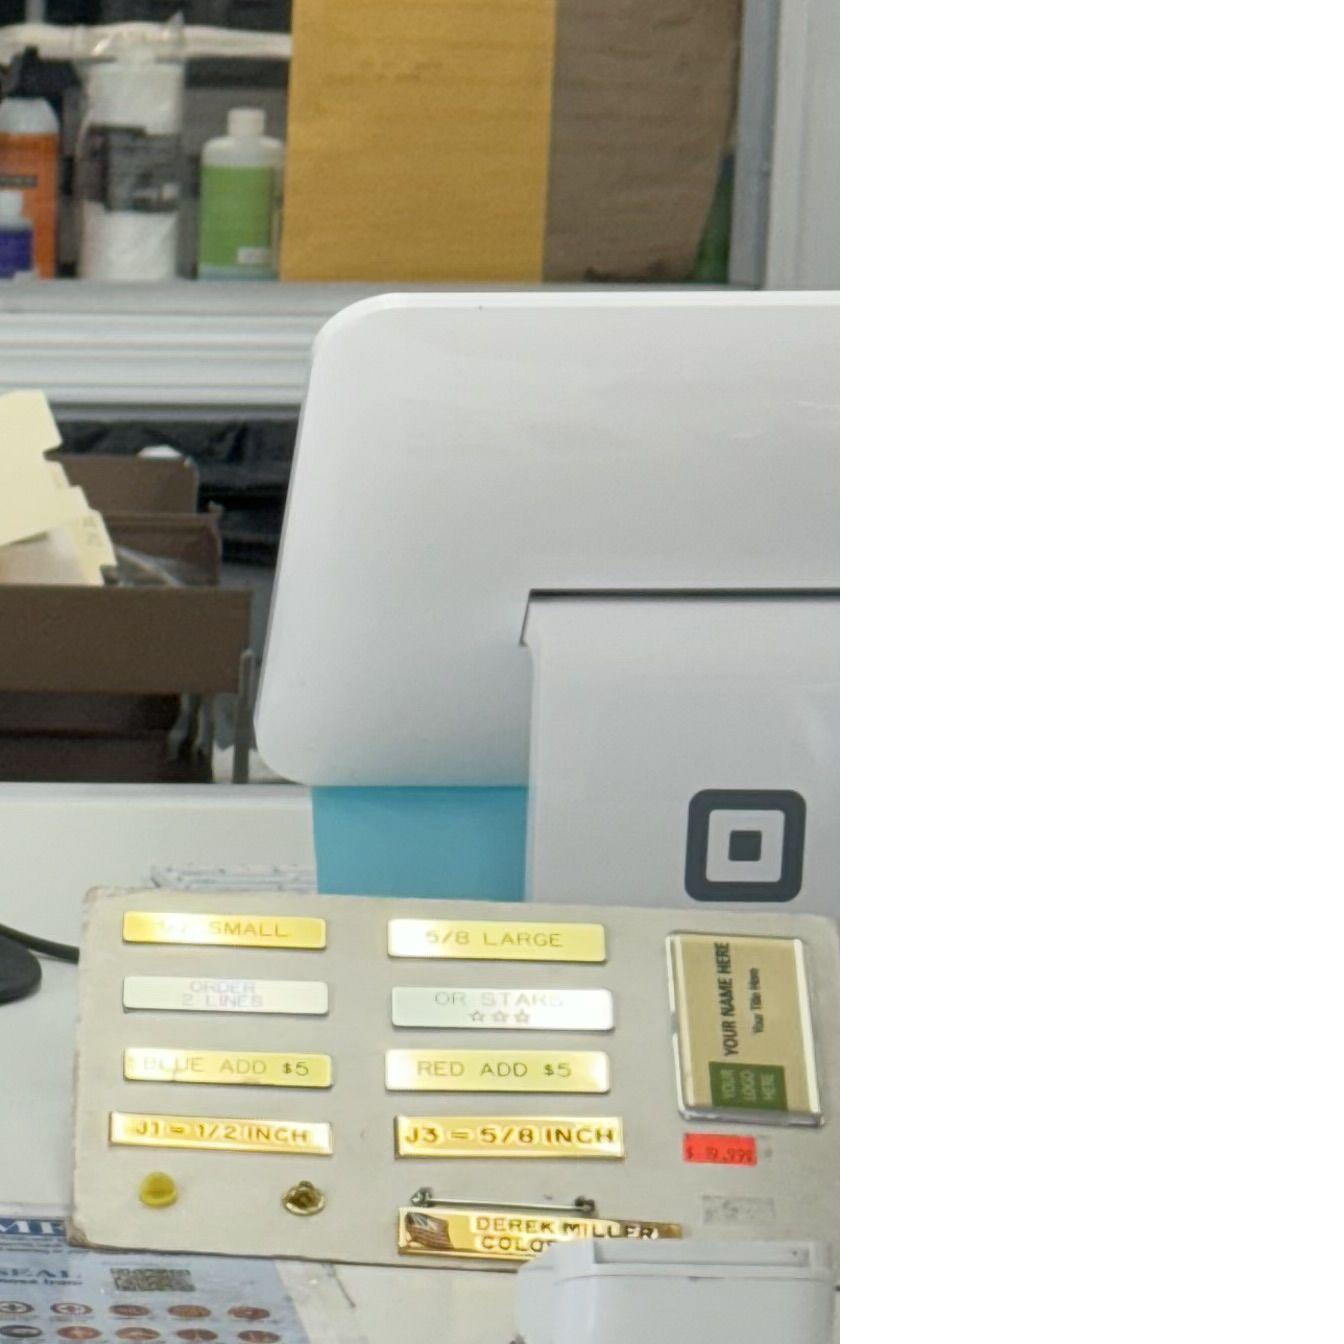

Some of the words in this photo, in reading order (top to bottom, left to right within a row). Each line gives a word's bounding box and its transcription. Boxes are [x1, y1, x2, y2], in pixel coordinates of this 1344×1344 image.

[208, 922, 289, 939] SMALL
[424, 929, 471, 946] 5/8
[483, 931, 564, 948] LARGE
[714, 941, 731, 974] HERE
[433, 991, 468, 1006] OR
[717, 977, 735, 1017] NAME
[722, 1019, 739, 1057] YOUR
[219, 1058, 267, 1074] ADD
[282, 1061, 310, 1077] $5
[416, 1060, 465, 1077] RED
[479, 1061, 529, 1077] ADD
[543, 1062, 572, 1078] $5
[134, 1119, 160, 1136] J1
[198, 1123, 241, 1140] 1/2
[247, 1126, 309, 1143] INCH
[405, 1127, 437, 1143] J3
[480, 1126, 535, 1144] 5/8
[545, 1126, 614, 1144] INCH
[475, 1216, 555, 1235] DEREK
[562, 1222, 656, 1241] MILLER
[481, 1236, 554, 1253] COLO
